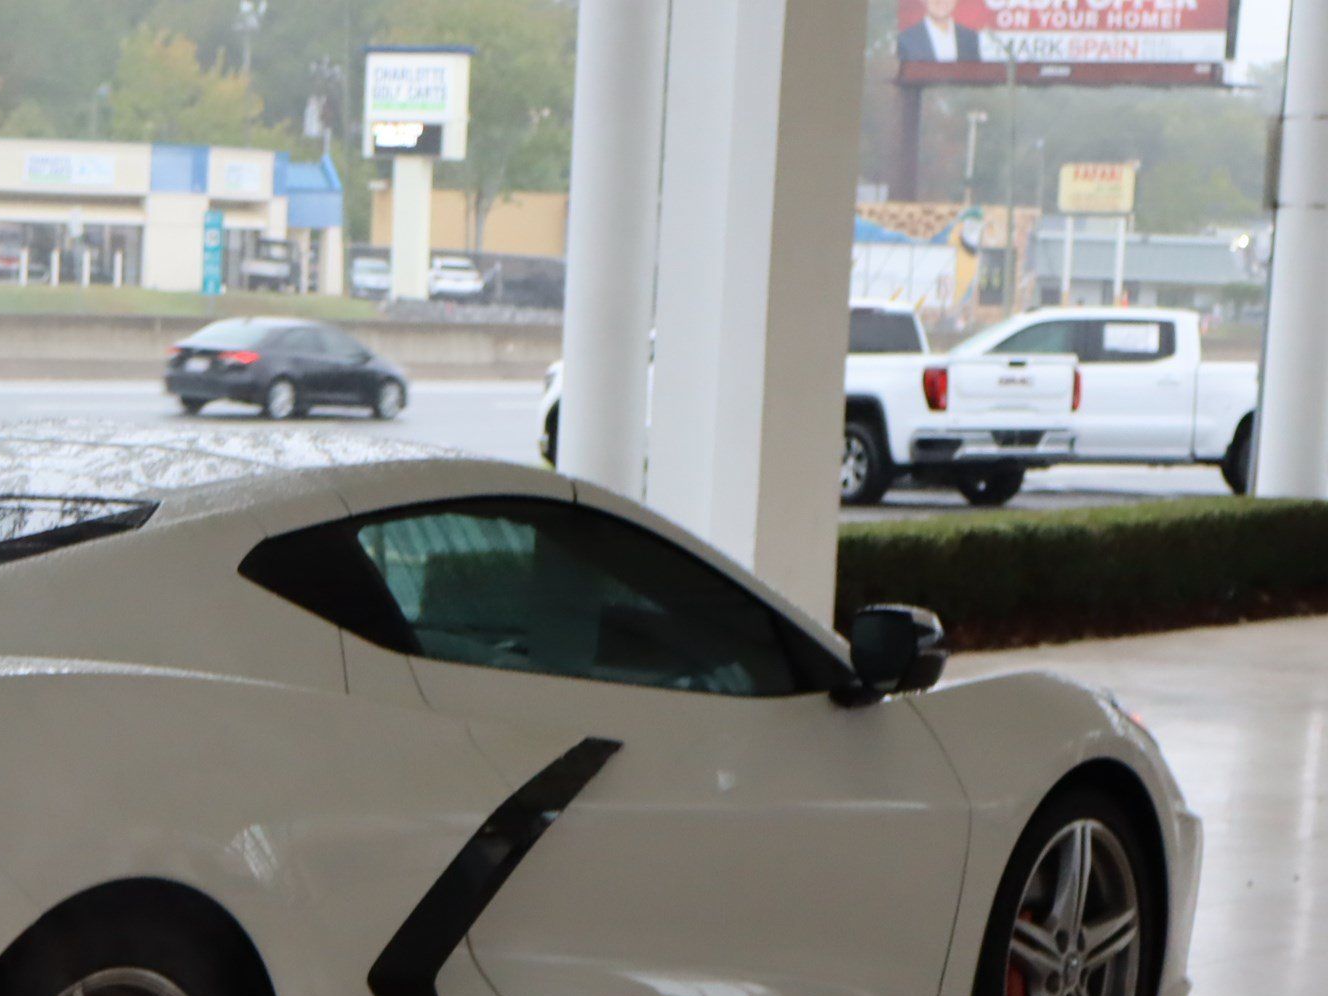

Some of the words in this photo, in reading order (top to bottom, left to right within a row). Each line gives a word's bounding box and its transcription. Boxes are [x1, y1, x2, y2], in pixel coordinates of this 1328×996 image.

[996, 9, 1030, 29] ON
[1038, 9, 1099, 29] YOUR
[1106, 9, 1182, 29] HOME!
[997, 36, 1063, 59] MARK
[1068, 36, 1139, 59] SPAIN
